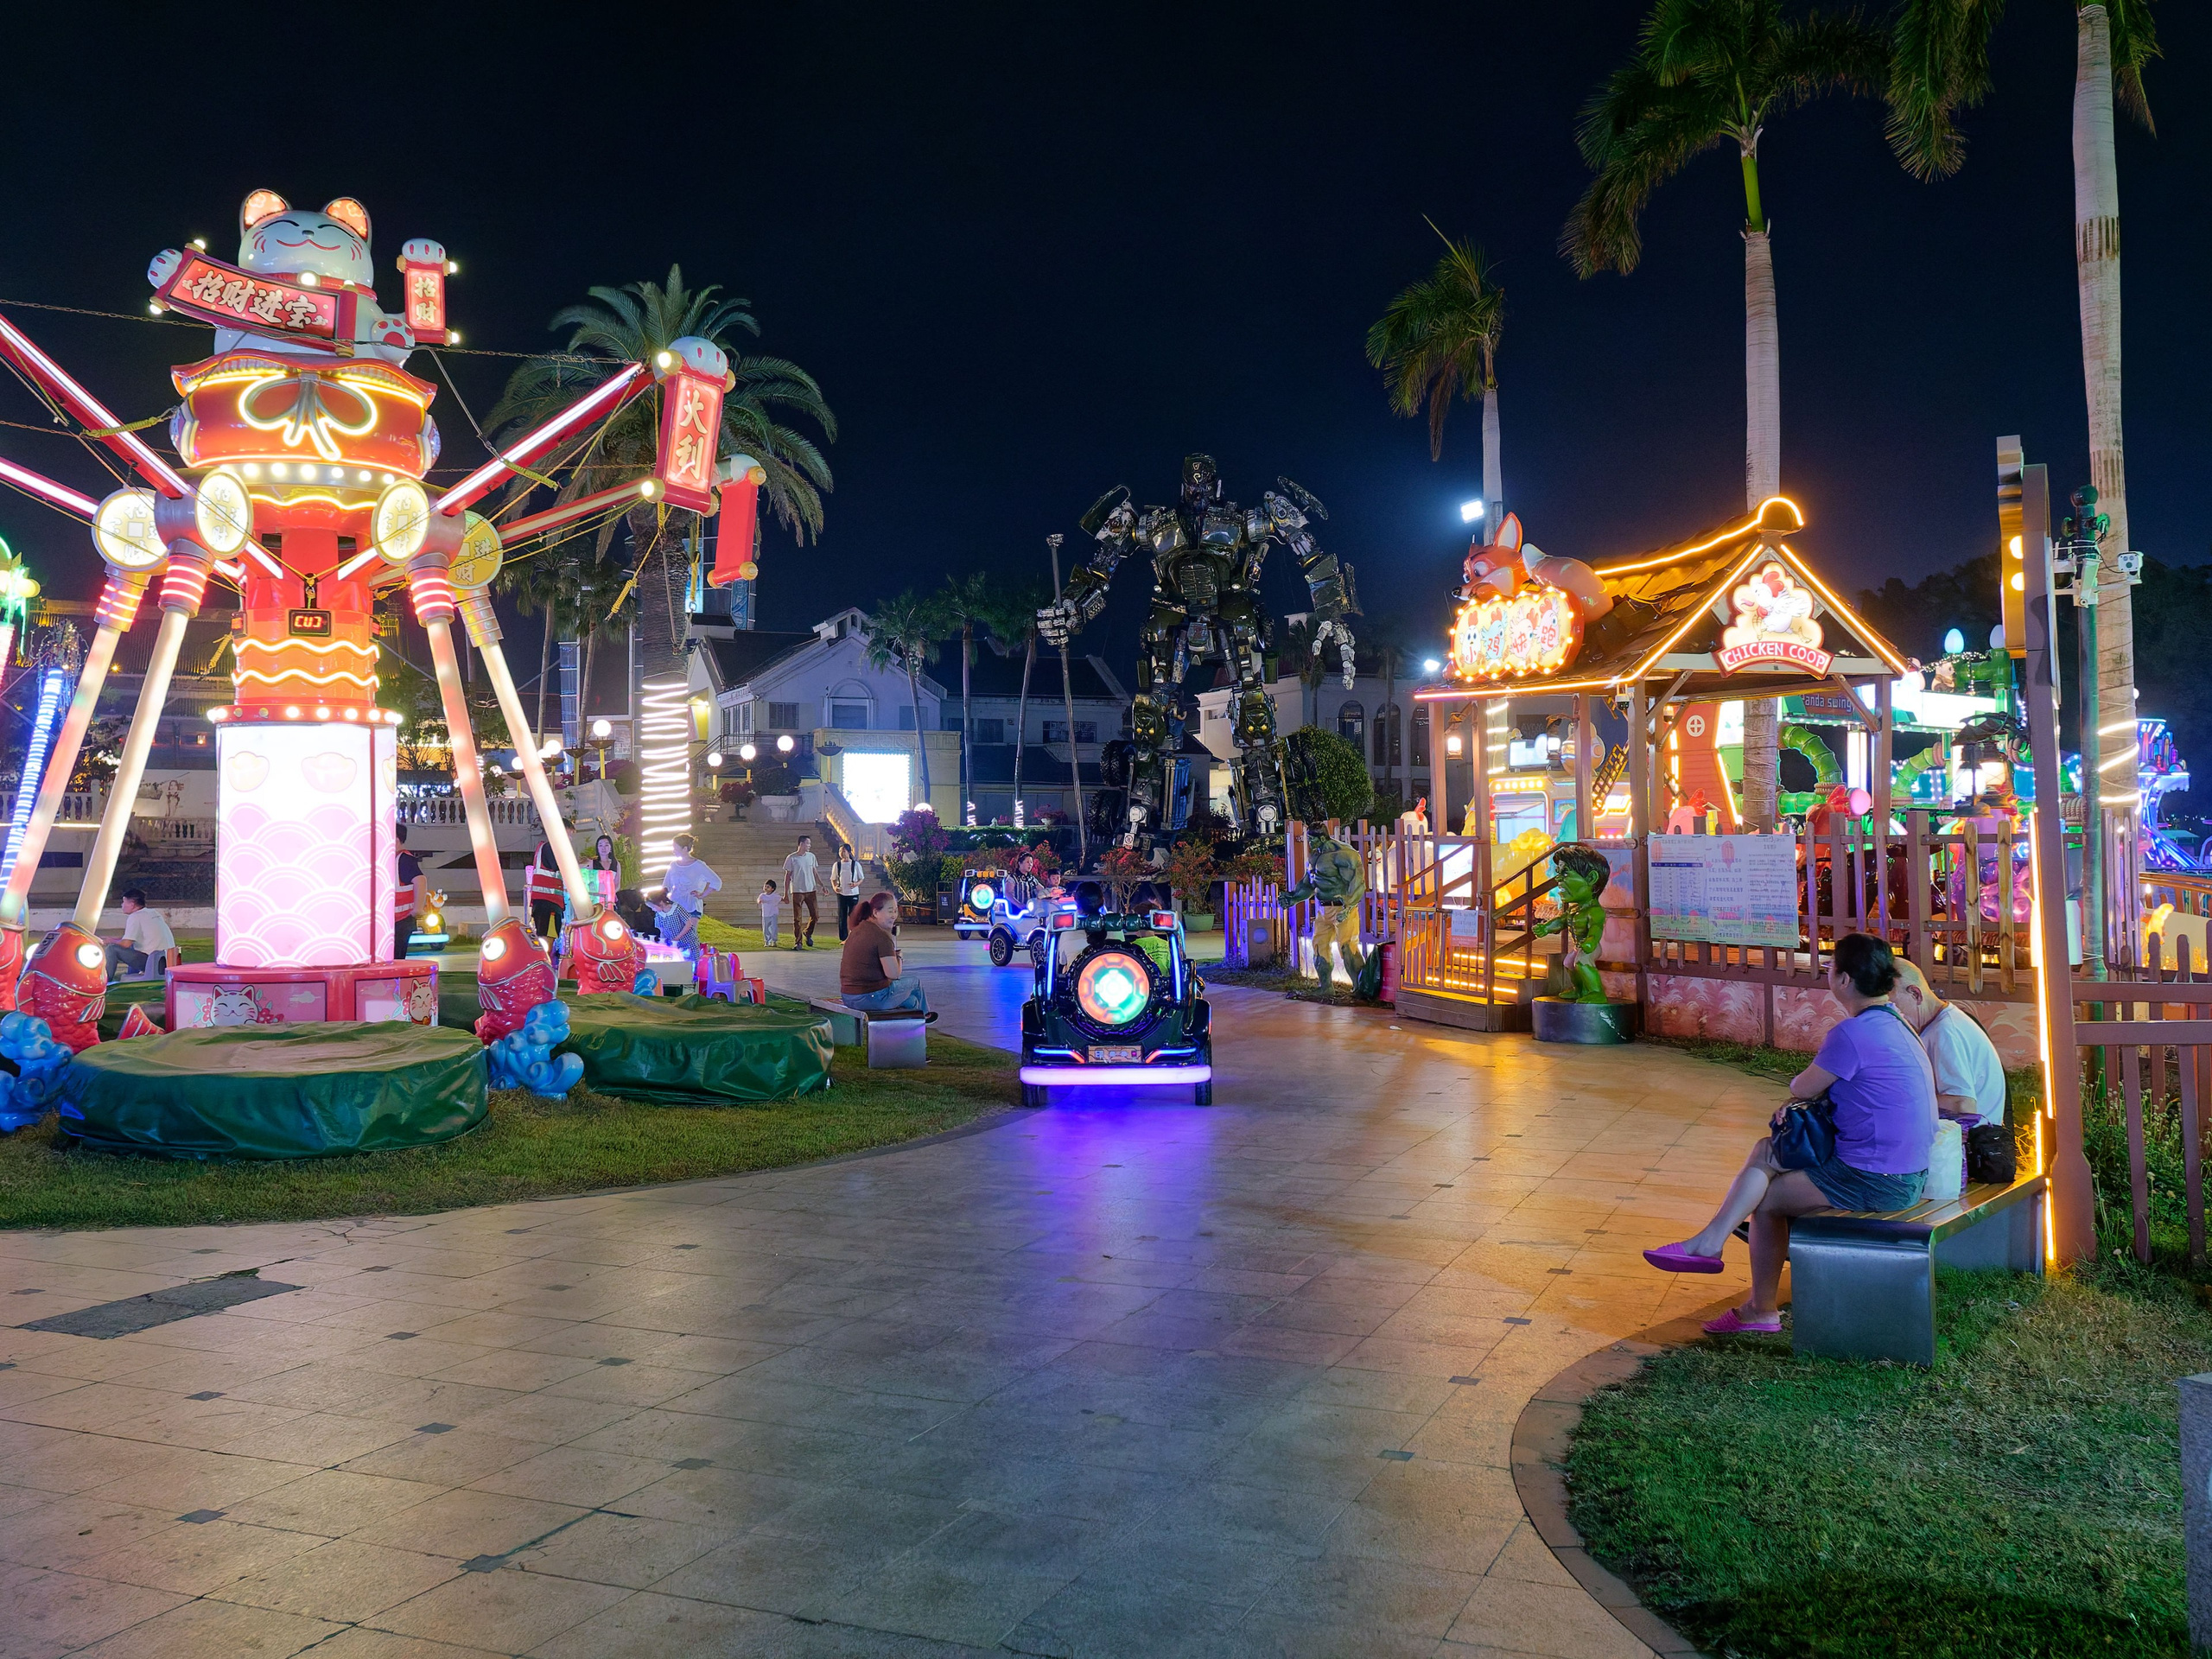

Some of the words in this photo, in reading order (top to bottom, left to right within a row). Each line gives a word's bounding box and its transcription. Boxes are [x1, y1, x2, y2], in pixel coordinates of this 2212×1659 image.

[192, 270, 318, 329] 招财进宝
[414, 276, 437, 324] 招财
[675, 389, 709, 480] 大利
[1465, 625, 1556, 664] 小鸡快跑
[1724, 642, 1784, 665] CHICKEN
[1789, 645, 1826, 667] COOP
[1800, 693, 1825, 708] anda
[1827, 696, 1852, 712] swing
